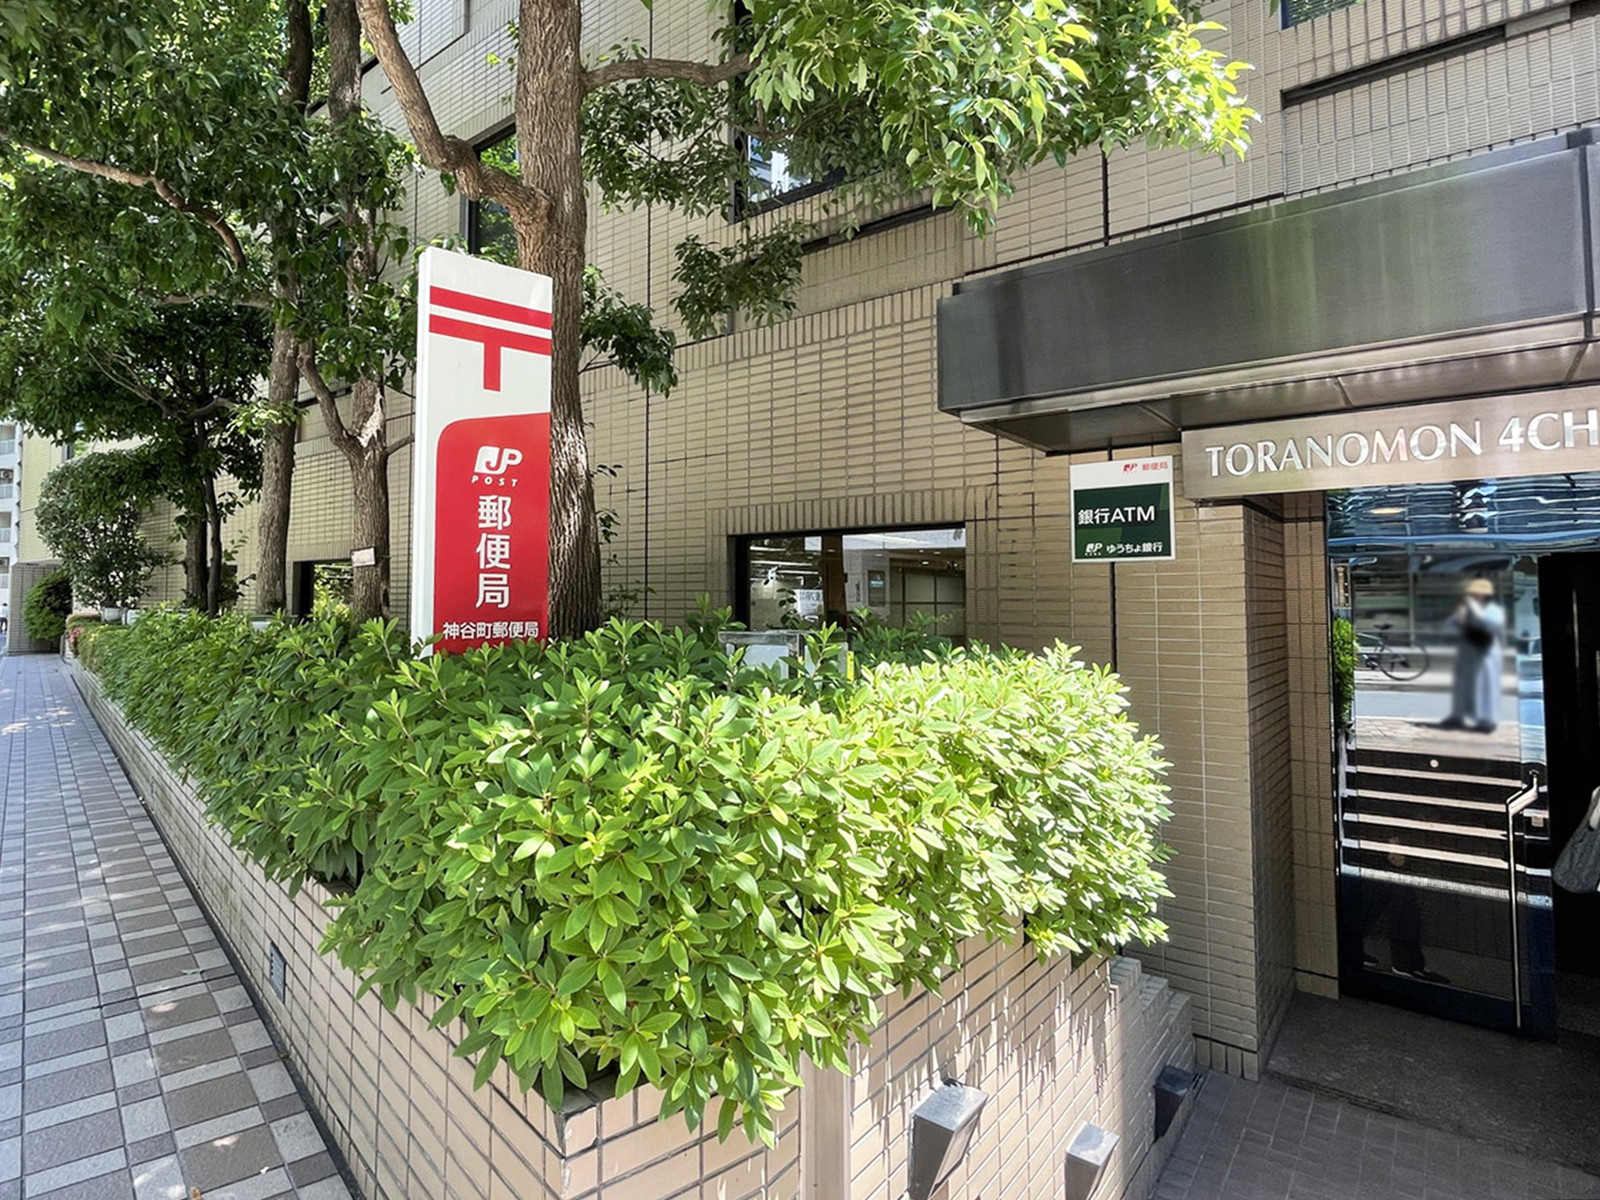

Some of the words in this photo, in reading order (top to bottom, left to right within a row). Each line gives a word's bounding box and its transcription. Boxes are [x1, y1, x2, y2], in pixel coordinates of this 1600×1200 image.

[1205, 419, 1483, 477] TORANOMON
[1499, 408, 1599, 452] 4CH
[474, 445, 523, 475] JP
[471, 476, 519, 487] POST
[1078, 505, 1155, 525] 銀行ATM
[475, 495, 512, 608] 郵便局
[1106, 541, 1163, 554] ゆうちょ銀行
[442, 621, 539, 640] 神谷町郵便局
